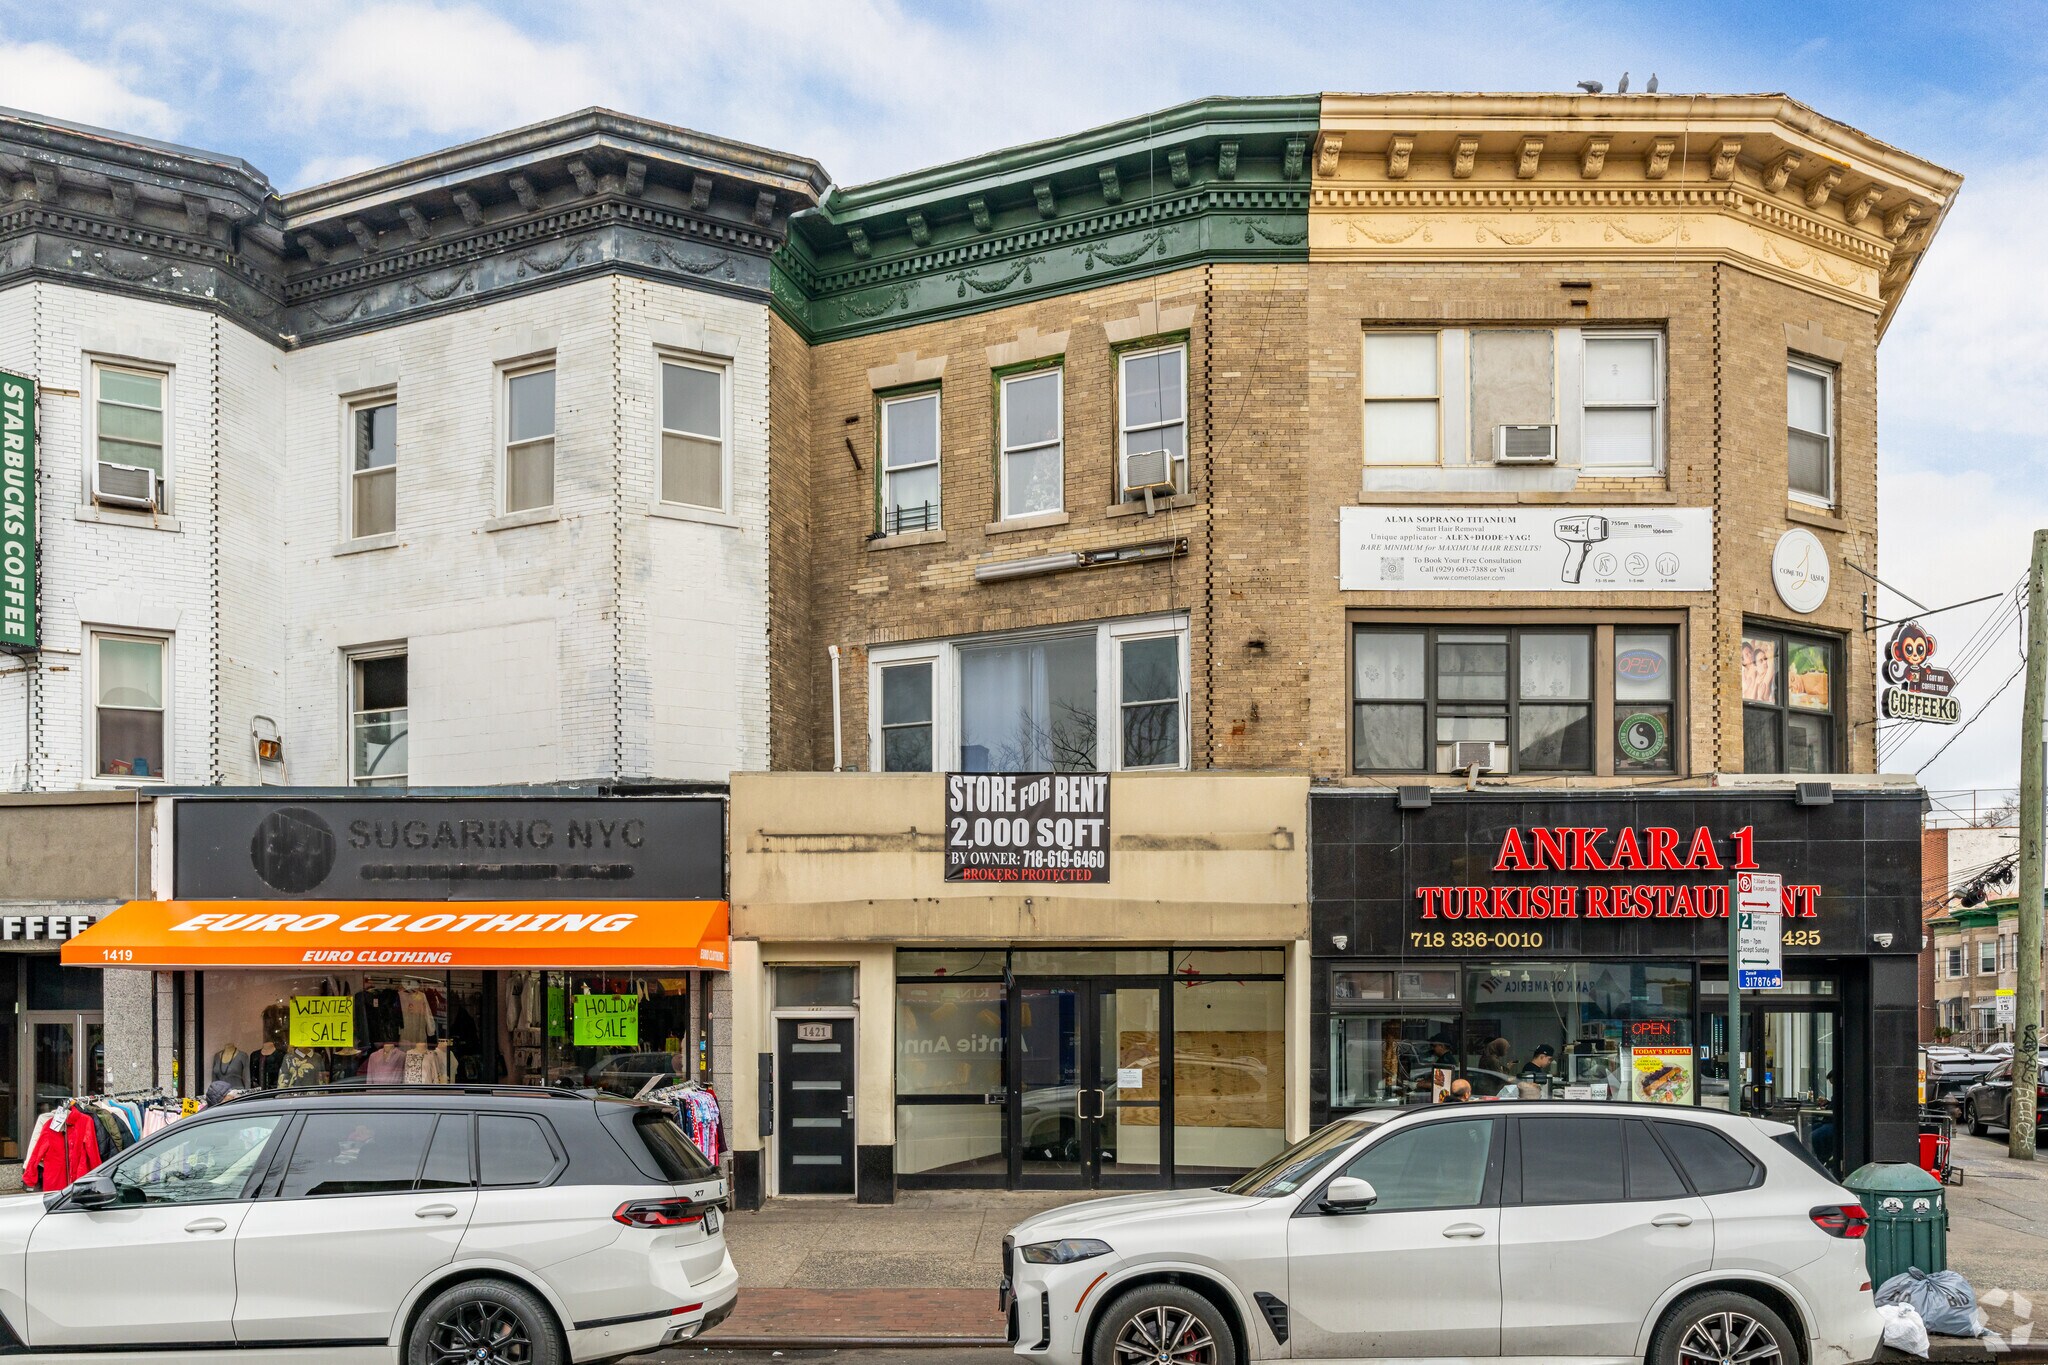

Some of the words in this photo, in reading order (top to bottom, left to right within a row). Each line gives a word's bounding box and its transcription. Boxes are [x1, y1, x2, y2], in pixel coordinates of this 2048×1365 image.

[3, 382, 26, 536] STARBUCKS
[1384, 516, 1413, 524] ALMA
[1416, 516, 1464, 524] SOPRANO
[1466, 516, 1517, 524] TITANIUM
[1370, 533, 1398, 541] Unique
[1399, 533, 1437, 542] applicator
[1360, 543, 1382, 551] BARE
[1424, 543, 1437, 552] for
[1437, 544, 1480, 552] MAXIMUM
[1481, 544, 1501, 552] HAIR
[1503, 544, 1542, 552] RESULTS!
[1413, 556, 1423, 564] To
[1424, 556, 1442, 564] Book
[1444, 556, 1461, 564] Your
[1462, 556, 1478, 564] Free
[1478, 556, 1522, 564] Consultation
[1419, 565, 1434, 573] Call
[1435, 565, 1455, 574] (929)
[1455, 565, 1488, 573] 603-7388
[1499, 565, 1515, 573] Visit
[1779, 567, 1795, 577] COME
[5, 538, 26, 637] COFFEE
[1617, 657, 1663, 674] OPEN
[1891, 689, 1957, 720] COFFEEKO
[950, 775, 1016, 813] STORE
[1019, 776, 1050, 812] FOR
[1054, 776, 1107, 813] RENT
[348, 817, 554, 850] SUGARING
[567, 817, 646, 849] NYC
[950, 817, 1030, 849] 2,000
[1036, 818, 1104, 849] SQFT
[1493, 826, 1724, 871] ANKARA
[1730, 825, 1760, 870] 1
[951, 852, 968, 865] BY
[970, 852, 1021, 865] OWNER:
[1023, 850, 1105, 868] 718-619-6460
[963, 868, 1019, 881] BROKERS
[1021, 869, 1092, 881] PROTECTED
[1416, 885, 1579, 920] TURKISH
[1584, 885, 1821, 919] RESTAUNT
[168, 913, 341, 932] EURO
[339, 913, 639, 933] CLOTHING
[1741, 913, 1749, 928] 2
[1411, 932, 1446, 948] 718
[1451, 932, 1543, 948] 336-0010
[1782, 930, 1821, 946] 425
[102, 949, 133, 961] 1419
[302, 950, 355, 963] EURO
[356, 950, 452, 964] CLOTHING
[1745, 977, 1771, 987] 317876
[295, 999, 352, 1016] WINTER
[585, 998, 637, 1017] HOLIDAY
[311, 1021, 347, 1042] SALE
[594, 1017, 627, 1039] SALE
[803, 1026, 826, 1037] 1421
[1631, 1022, 1671, 1035] OPEN
[694, 1189, 704, 1198] X7
